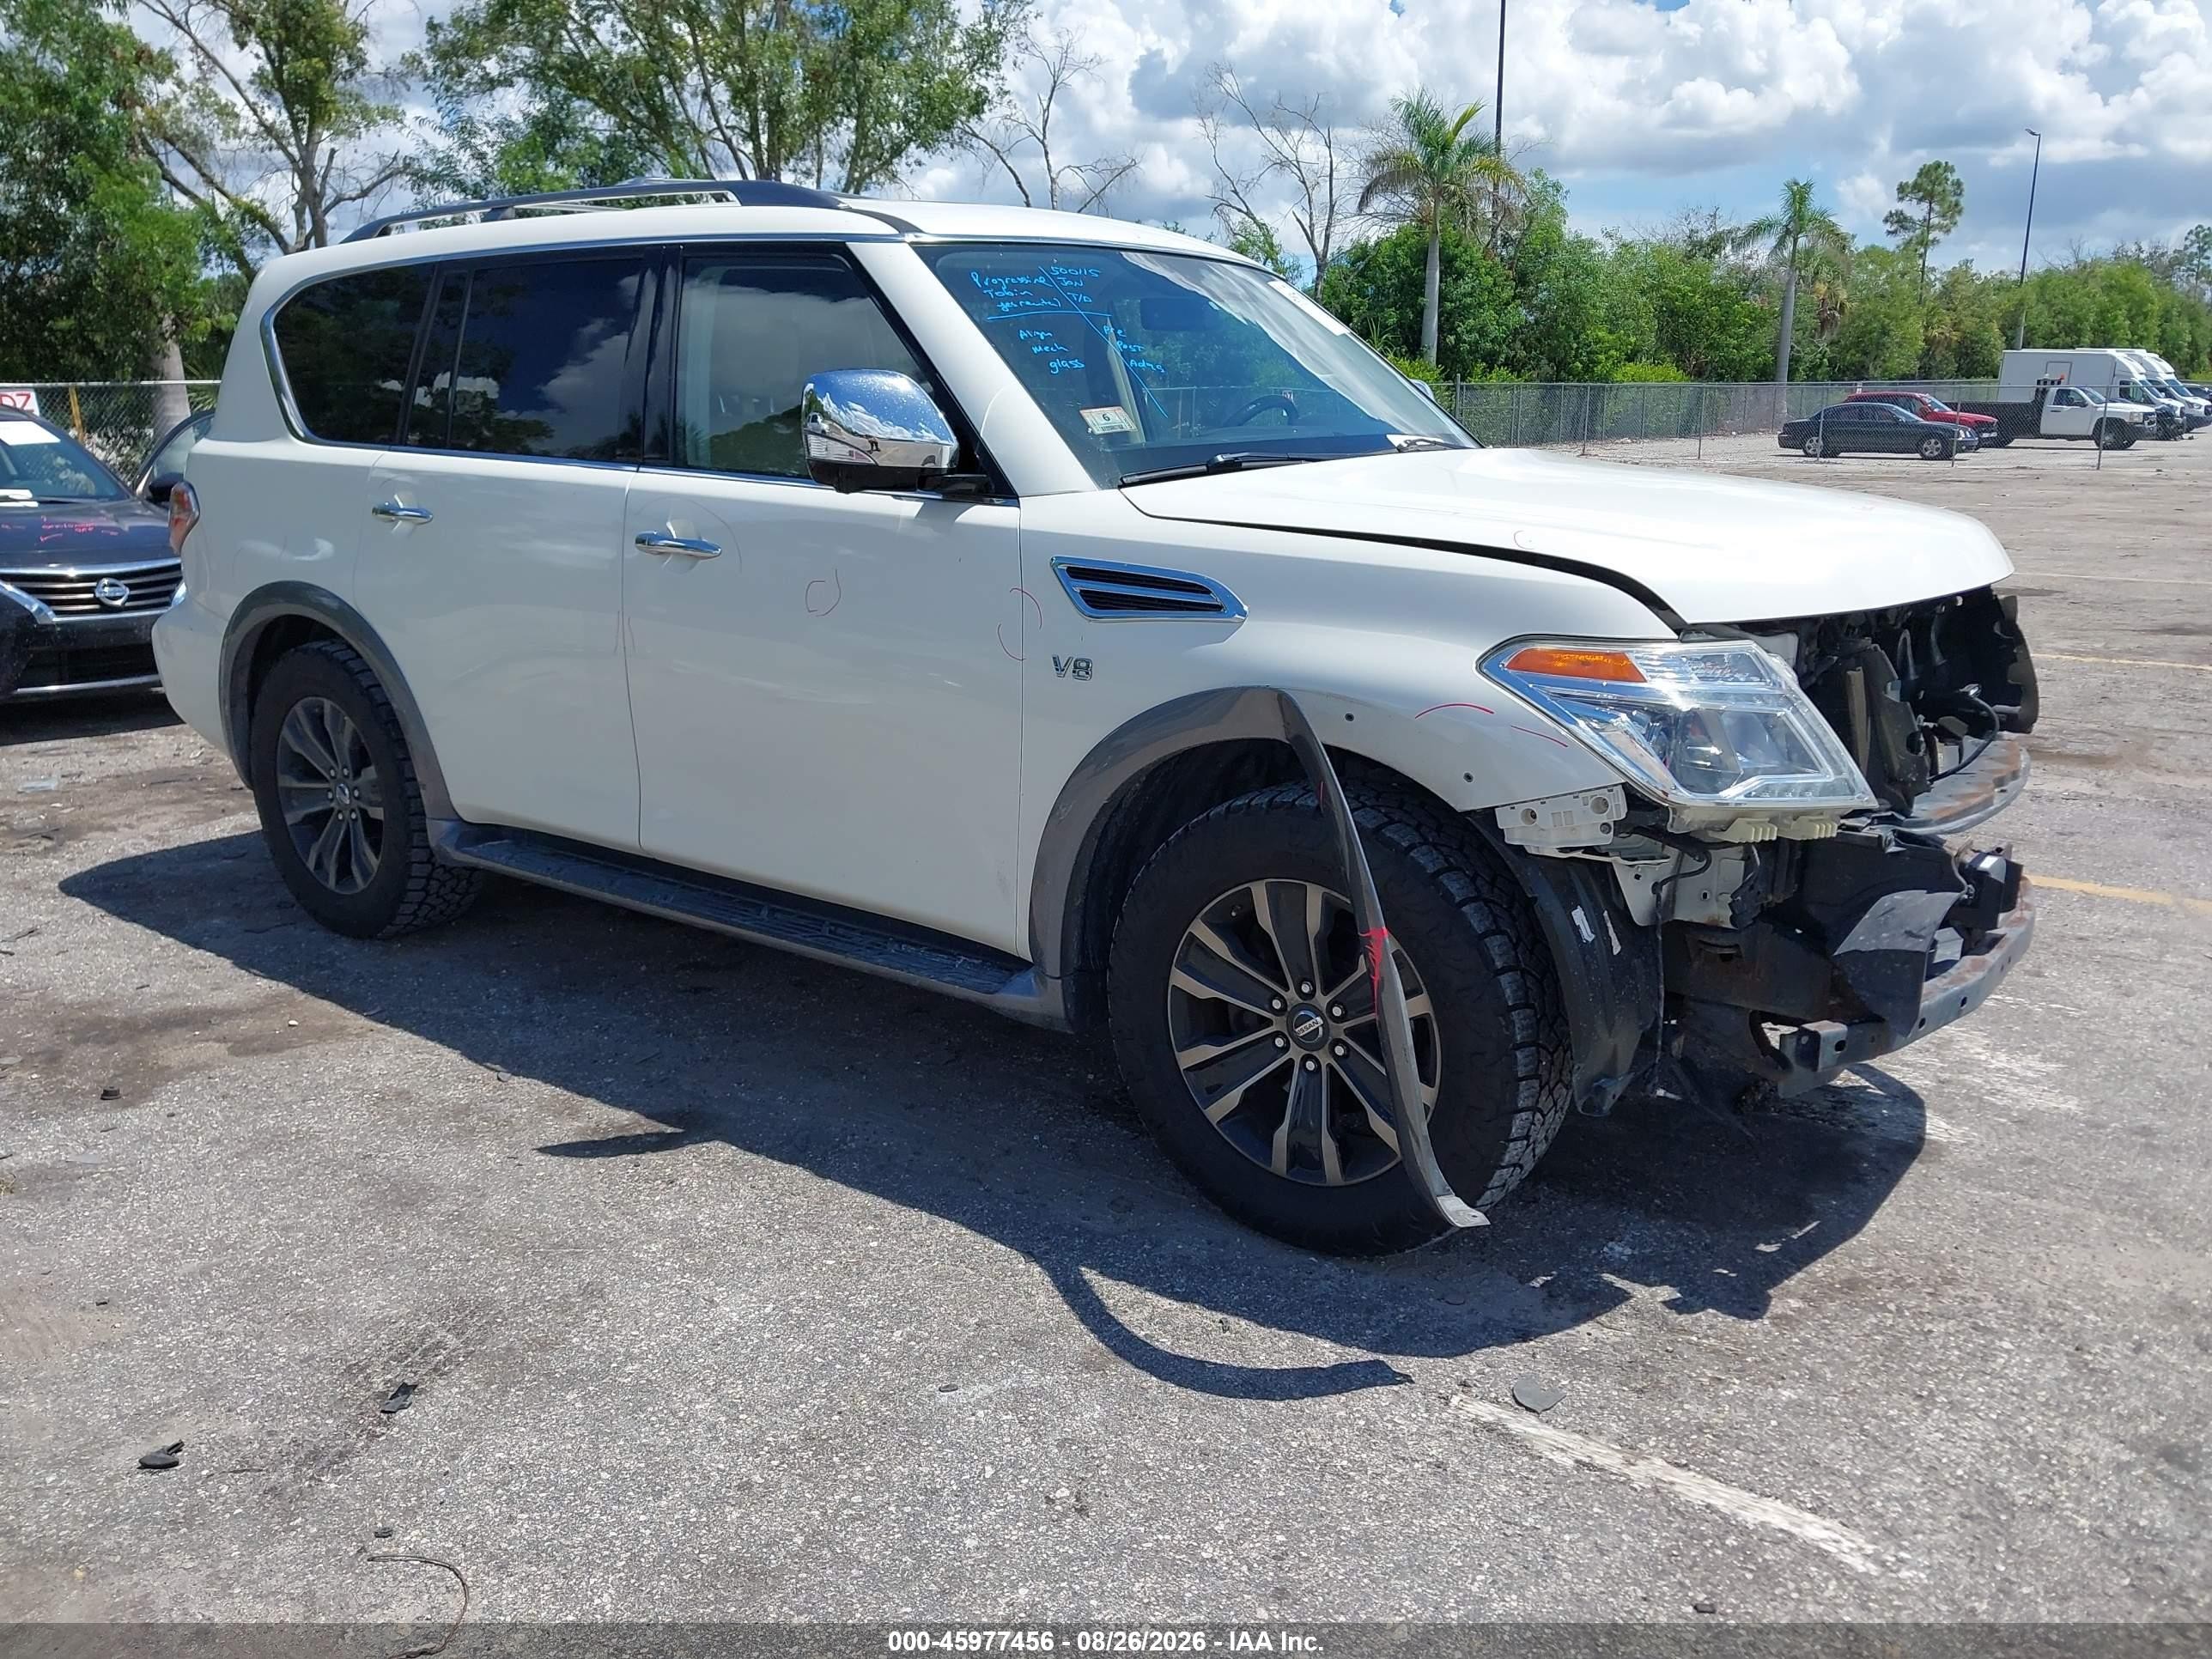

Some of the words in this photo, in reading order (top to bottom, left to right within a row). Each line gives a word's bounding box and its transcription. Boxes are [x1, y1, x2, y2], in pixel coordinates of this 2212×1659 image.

[1031, 343, 1071, 354] Mech
[1048, 358, 1086, 374] glass
[1103, 413, 1111, 422] 6
[1051, 654, 1093, 681] V8
